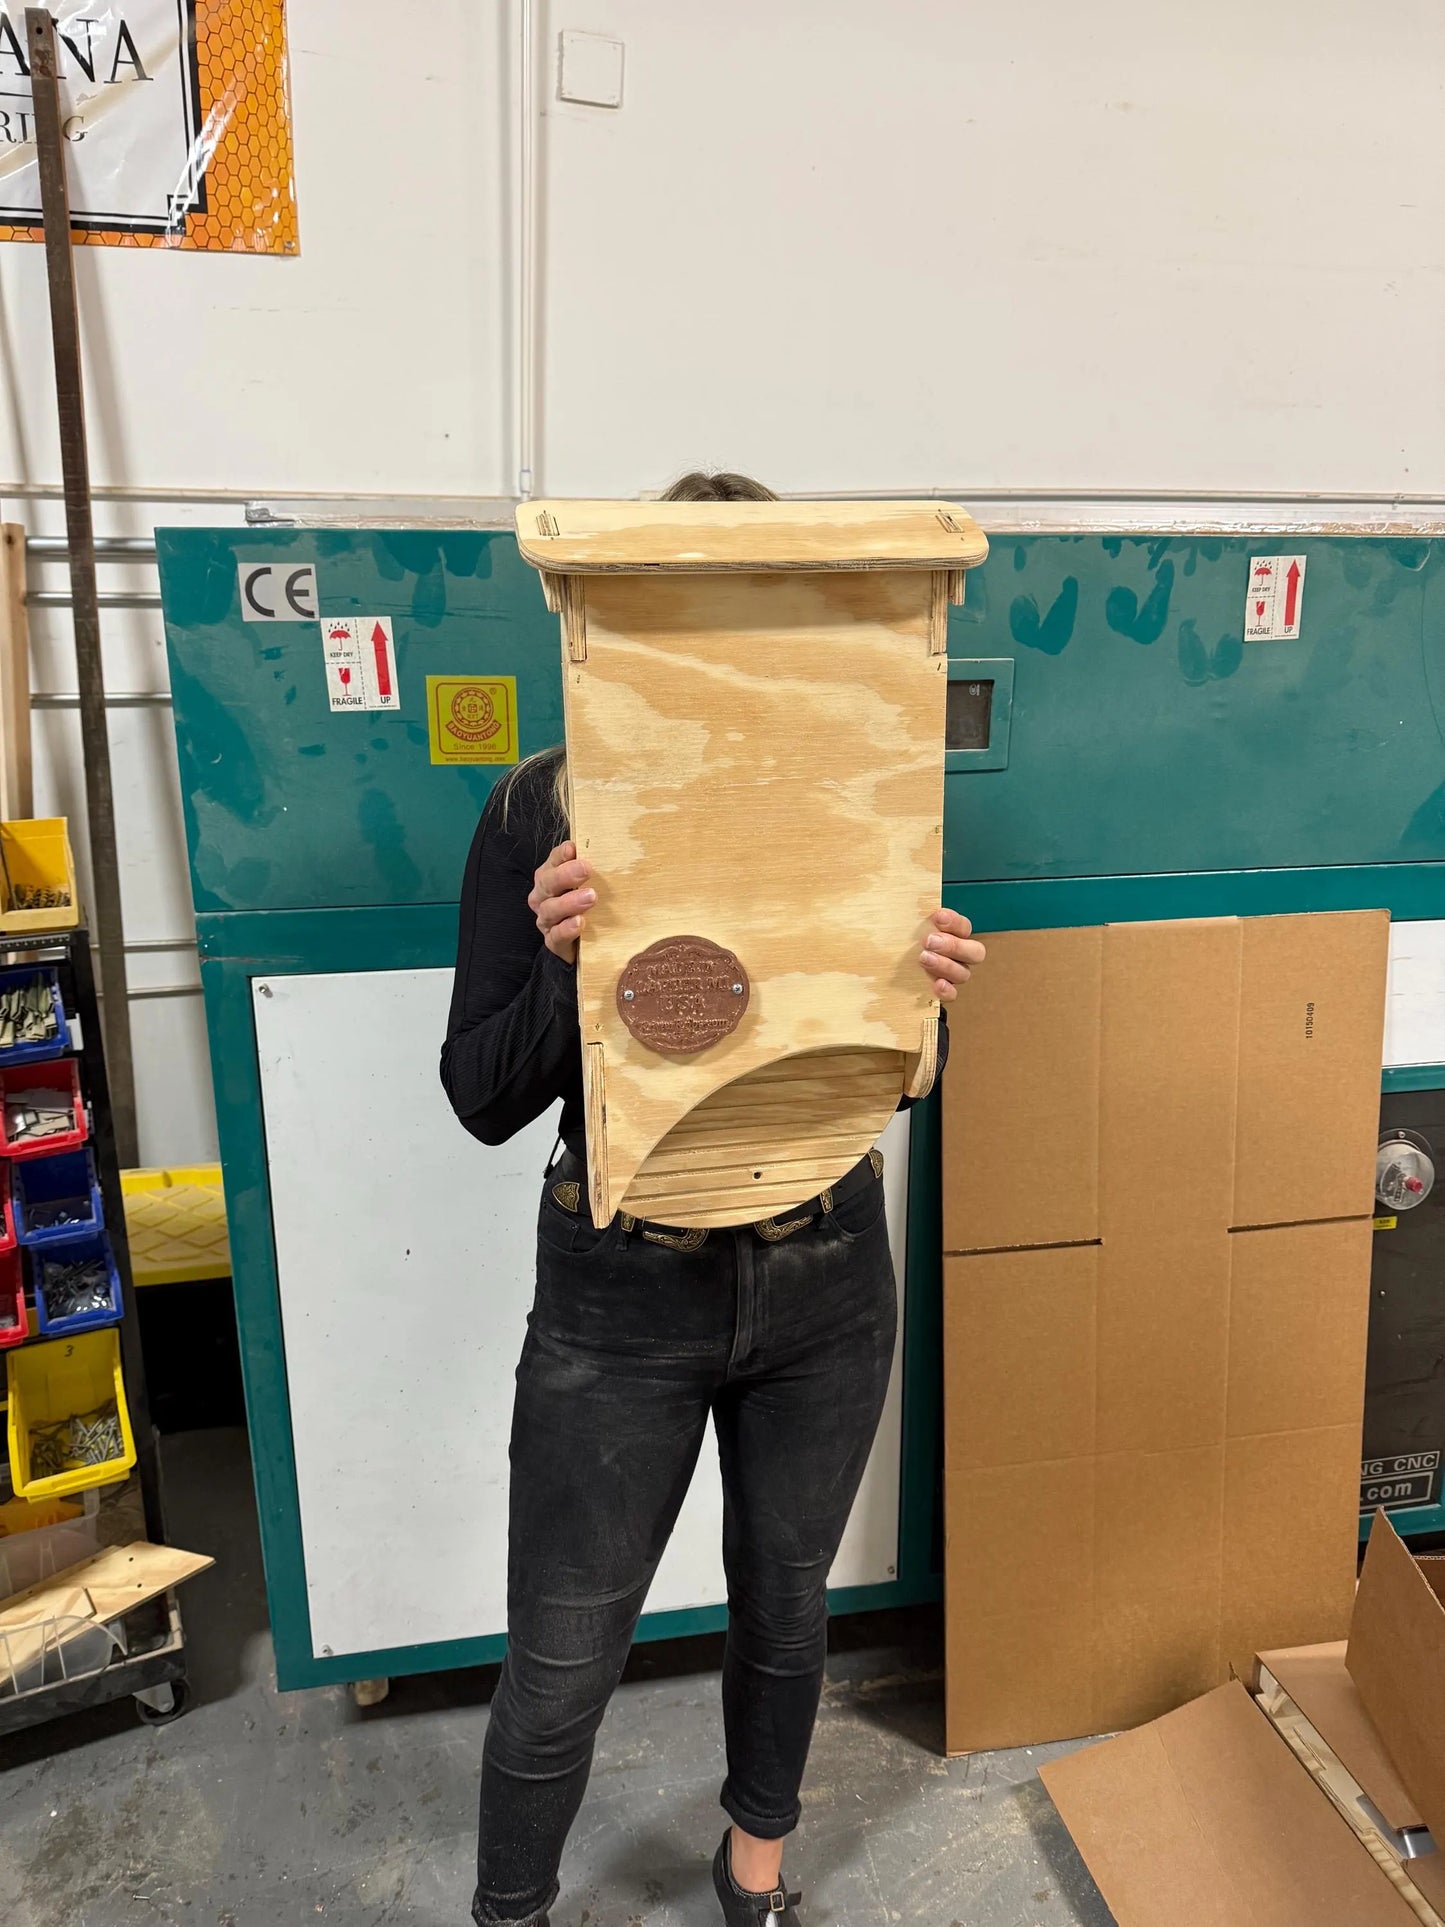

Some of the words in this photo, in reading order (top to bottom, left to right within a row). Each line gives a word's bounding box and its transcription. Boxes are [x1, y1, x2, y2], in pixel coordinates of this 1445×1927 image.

[0, 109, 89, 144] RIG
[244, 566, 316, 618] CE
[1246, 626, 1271, 636] FRAGILE
[1284, 626, 1294, 634] UP
[331, 696, 363, 706] FRAGILE
[380, 696, 391, 705] UP
[446, 721, 501, 741] BAOYUANTONG
[453, 743, 475, 751] Since
[1393, 1454, 1436, 1472] CNC
